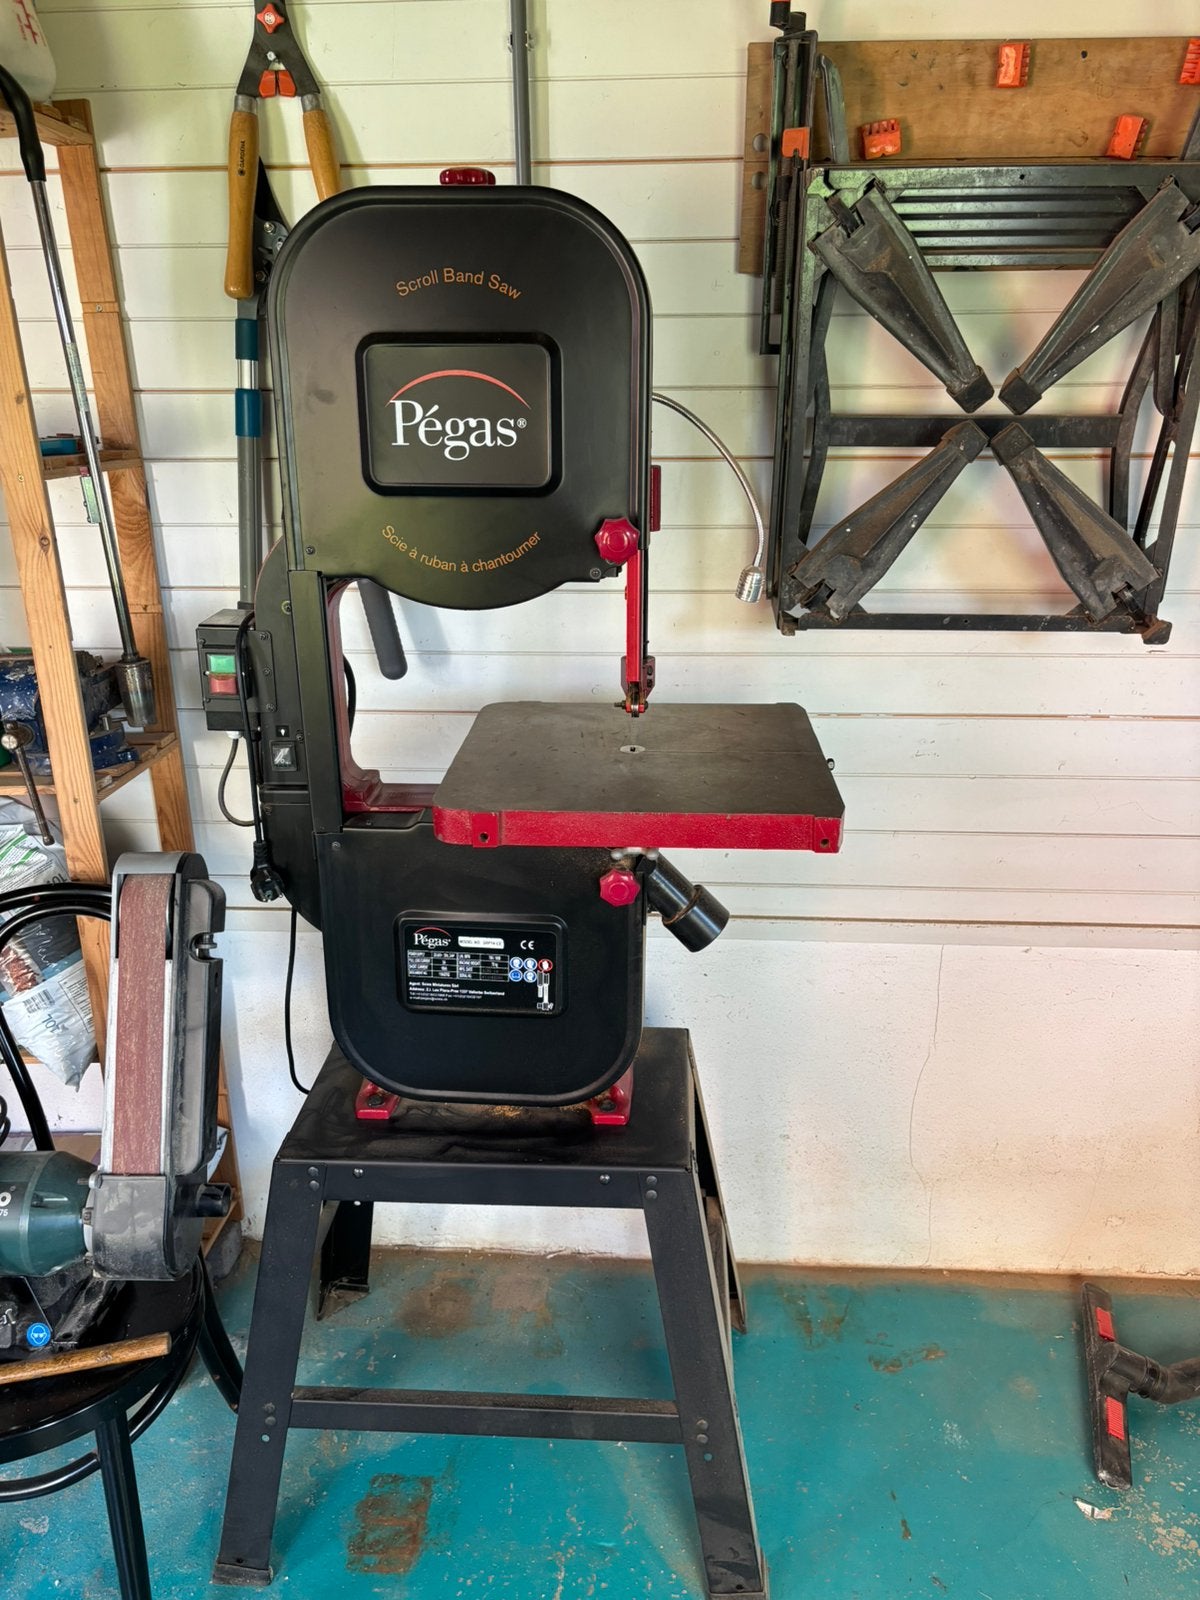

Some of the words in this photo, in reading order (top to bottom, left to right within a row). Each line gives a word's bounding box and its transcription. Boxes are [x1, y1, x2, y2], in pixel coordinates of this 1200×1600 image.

[396, 269, 439, 297] Scroll
[443, 267, 485, 285] Band
[488, 274, 522, 300] Saw
[382, 525, 408, 552] Scie
[408, 546, 418, 560] à
[420, 556, 457, 572] ruban
[460, 560, 469, 573] à
[471, 531, 542, 573] chantourner
[520, 940, 535, 950] CE
[41, 1013, 60, 1034] 10L
